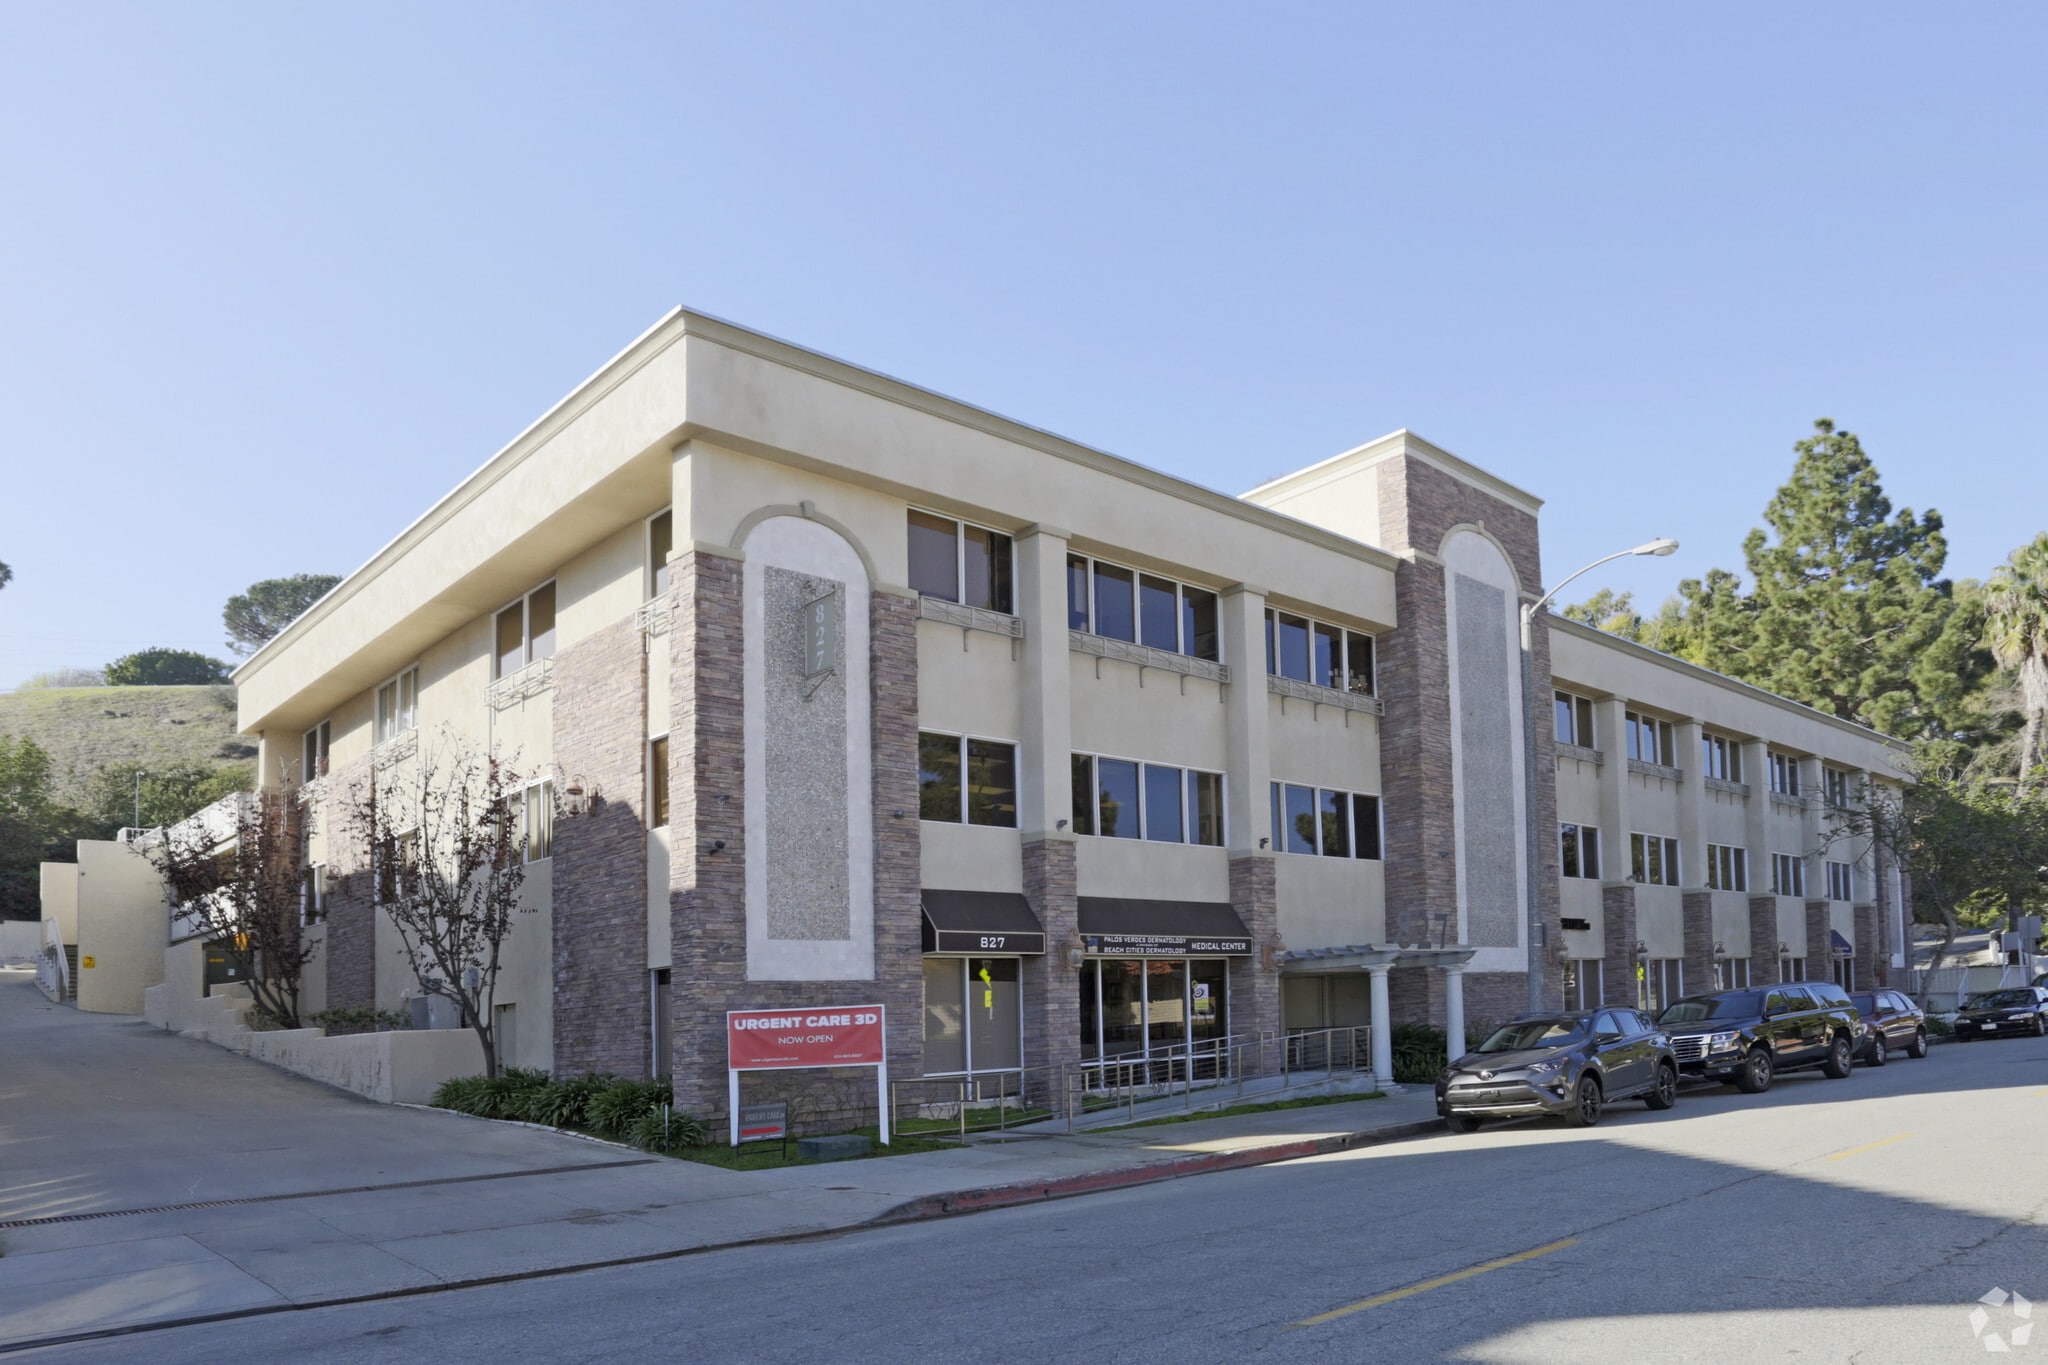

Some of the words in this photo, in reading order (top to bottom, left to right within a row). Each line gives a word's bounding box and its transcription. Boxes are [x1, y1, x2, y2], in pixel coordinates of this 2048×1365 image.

[815, 604, 825, 670] 827
[980, 937, 1006, 949] 827
[1191, 942, 1220, 950] MEDICAL
[1221, 942, 1247, 950] CENTER
[734, 1016, 803, 1031] URGENT
[805, 1014, 851, 1028] CARE
[854, 1013, 878, 1025] 3D
[778, 1036, 804, 1045] NOW
[806, 1035, 834, 1043] OPEN
